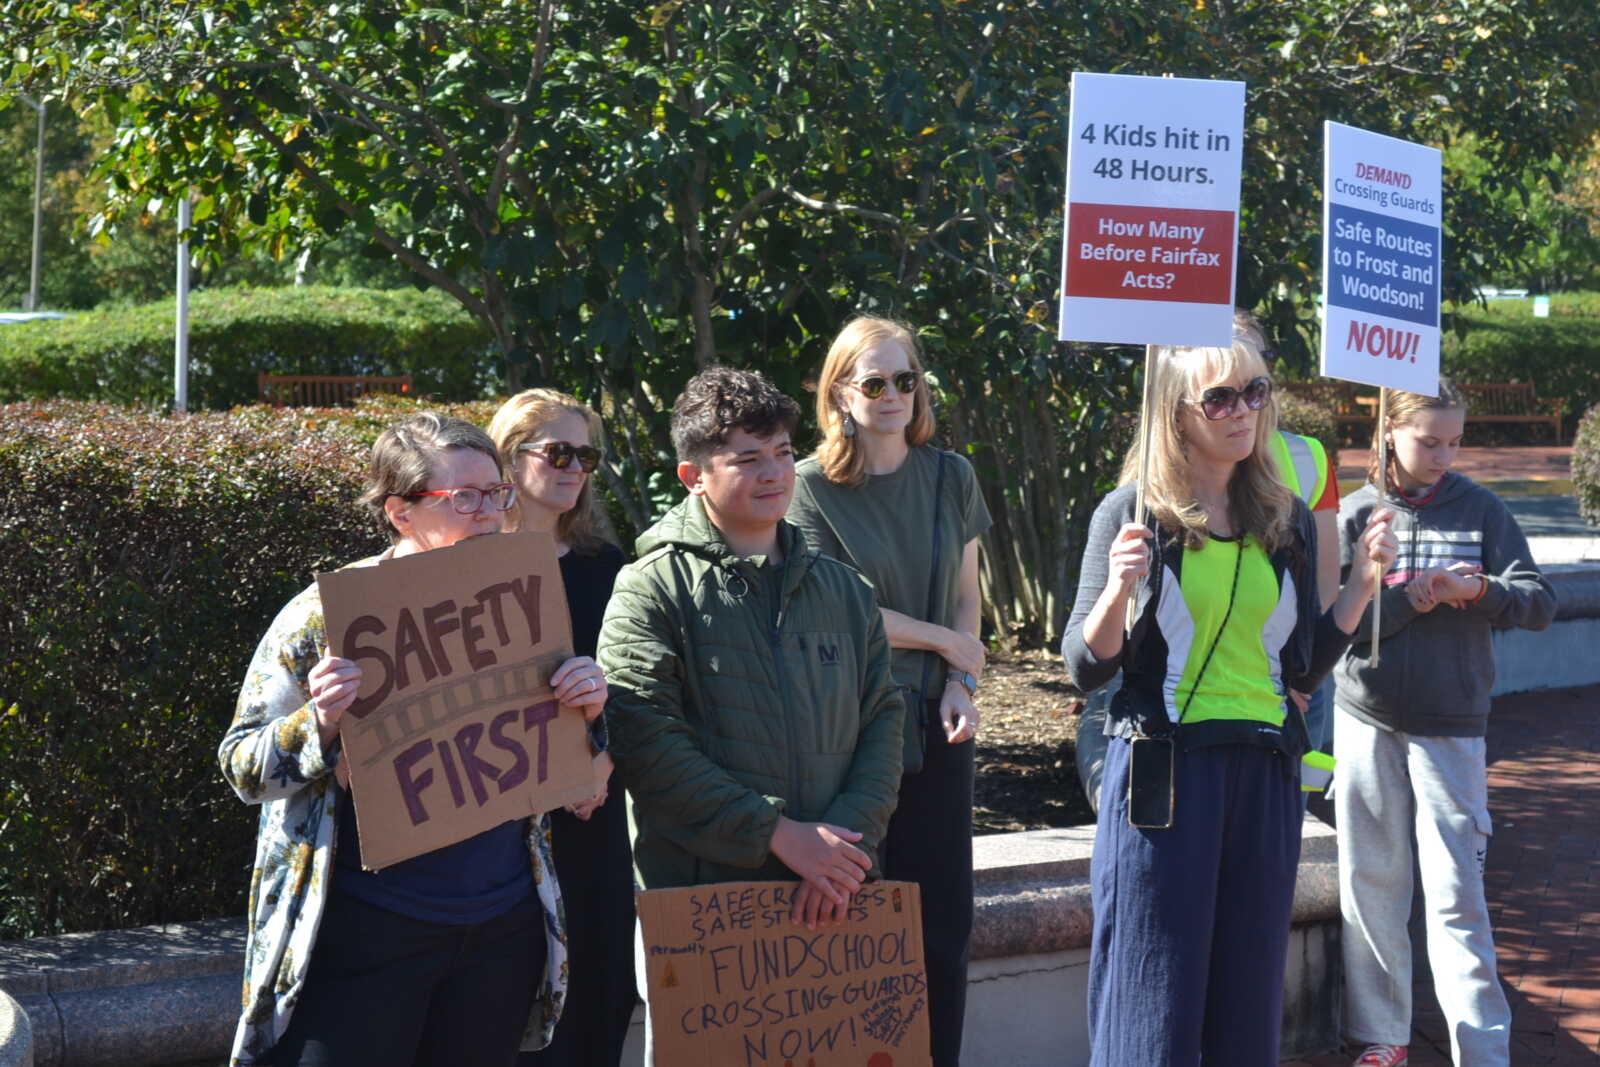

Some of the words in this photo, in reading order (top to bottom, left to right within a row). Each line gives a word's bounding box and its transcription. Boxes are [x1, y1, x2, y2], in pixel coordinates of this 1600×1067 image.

[1080, 123, 1096, 144] 4
[1103, 123, 1157, 148] Kids
[1164, 126, 1200, 150] hit
[1207, 128, 1230, 151] in
[1093, 157, 1124, 179] 48
[1131, 159, 1215, 184] Hours.
[1355, 162, 1412, 190] DEMAND
[1334, 178, 1388, 207] Crossing
[1391, 192, 1434, 215] Guards
[1099, 218, 1144, 237] How
[1149, 221, 1205, 244] Many
[1335, 218, 1371, 244] Safe
[1376, 227, 1433, 258] Routes
[1080, 243, 1146, 263] Before
[1151, 246, 1220, 267] Fairfax
[1334, 247, 1352, 266] to
[1356, 251, 1399, 278] Frost
[1402, 265, 1433, 286] and
[1122, 271, 1176, 290] Acts?
[1342, 274, 1424, 311] Woodson!
[1346, 320, 1420, 364] NOW!
[342, 575, 542, 719] SAFETY
[393, 699, 560, 826] FIRST
[690, 888, 755, 916] SAFE
[692, 909, 755, 941] SAFE
[681, 986, 839, 1034] CROSSING
[842, 971, 926, 1002] GUARDS
[743, 1016, 857, 1065] NOW!
